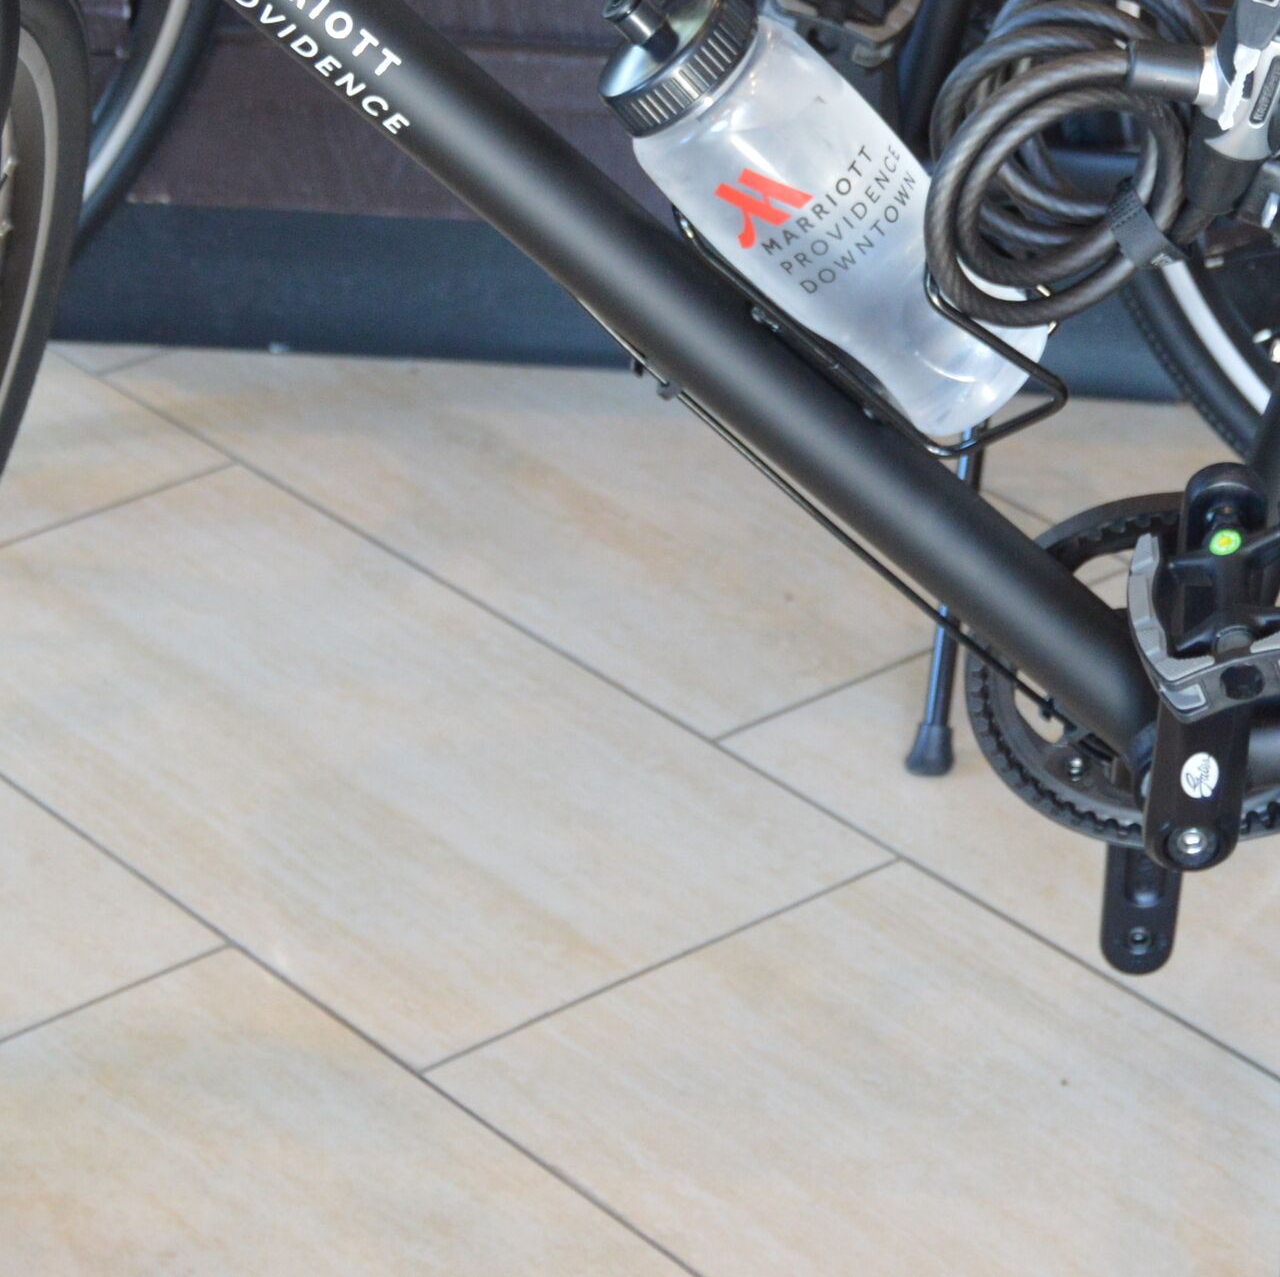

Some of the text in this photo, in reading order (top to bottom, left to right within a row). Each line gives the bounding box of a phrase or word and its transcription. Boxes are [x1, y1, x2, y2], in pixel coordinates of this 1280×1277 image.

[760, 144, 873, 256] MARRIOTT
[779, 143, 901, 276] PROVIDENCE
[799, 171, 918, 295] DOWNTOWN
